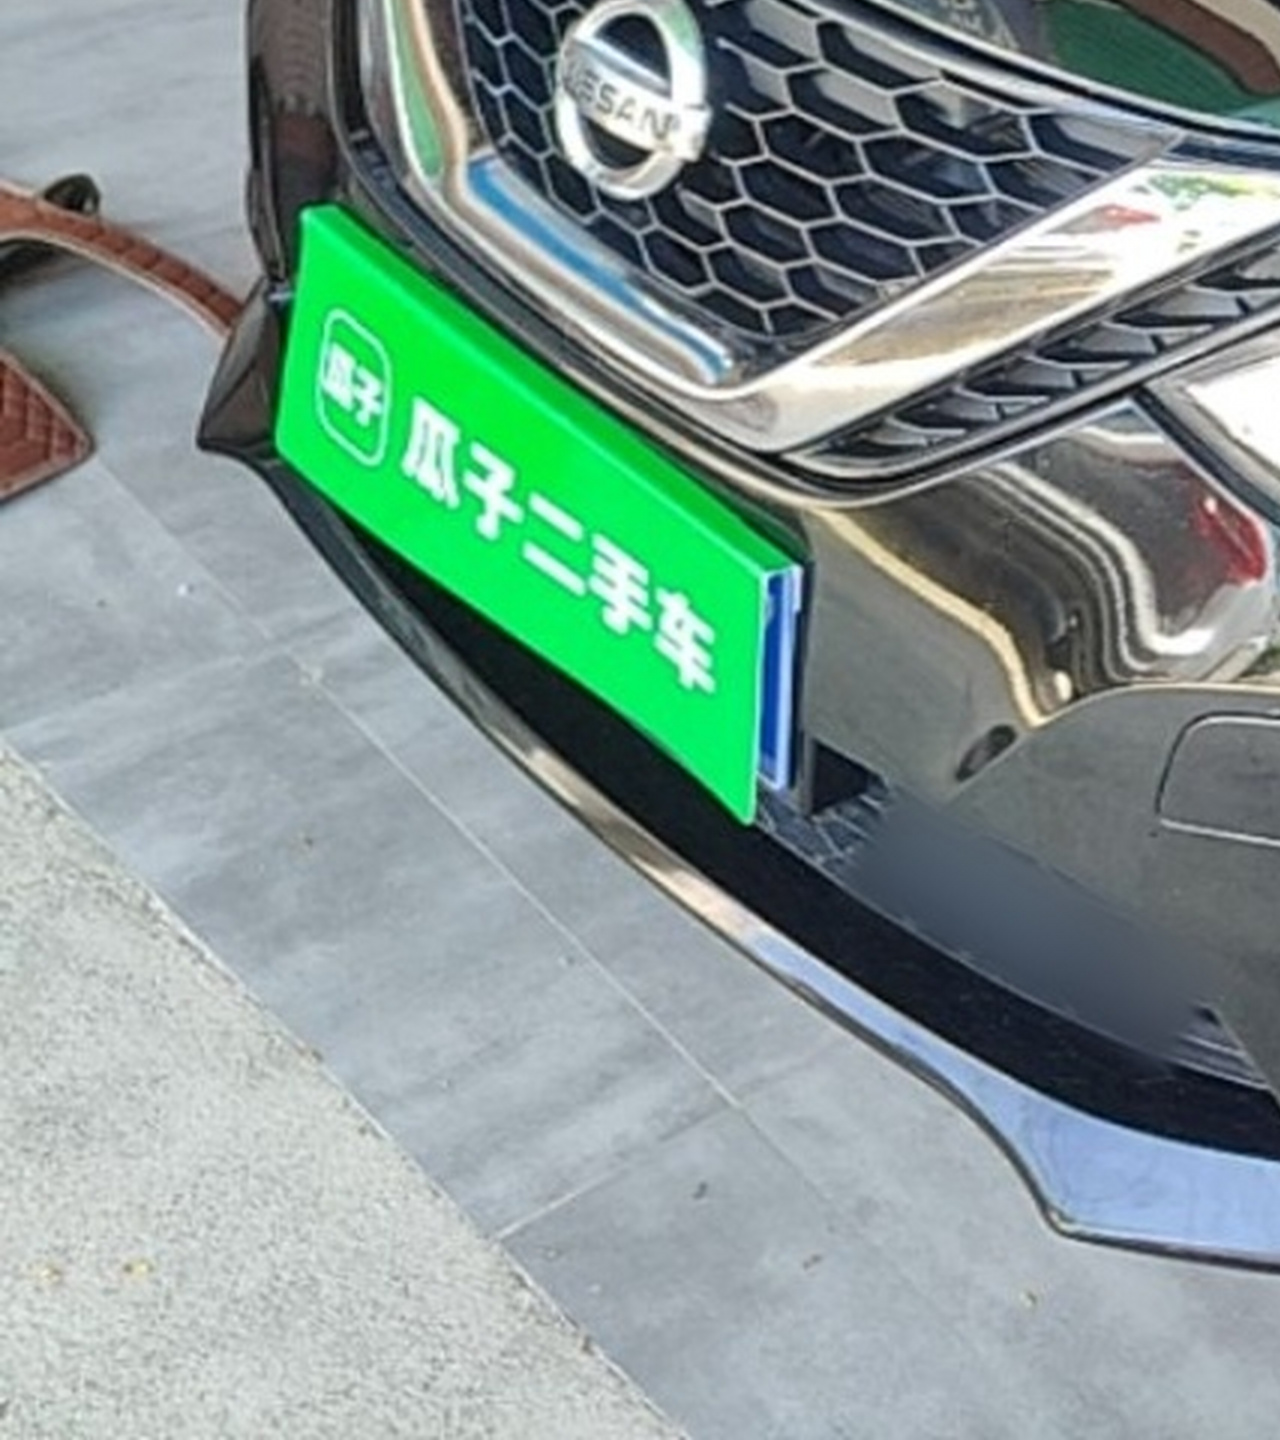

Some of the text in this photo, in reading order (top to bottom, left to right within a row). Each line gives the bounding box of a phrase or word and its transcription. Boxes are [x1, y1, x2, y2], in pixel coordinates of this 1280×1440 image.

[401, 397, 717, 695] 瓜子二手车
